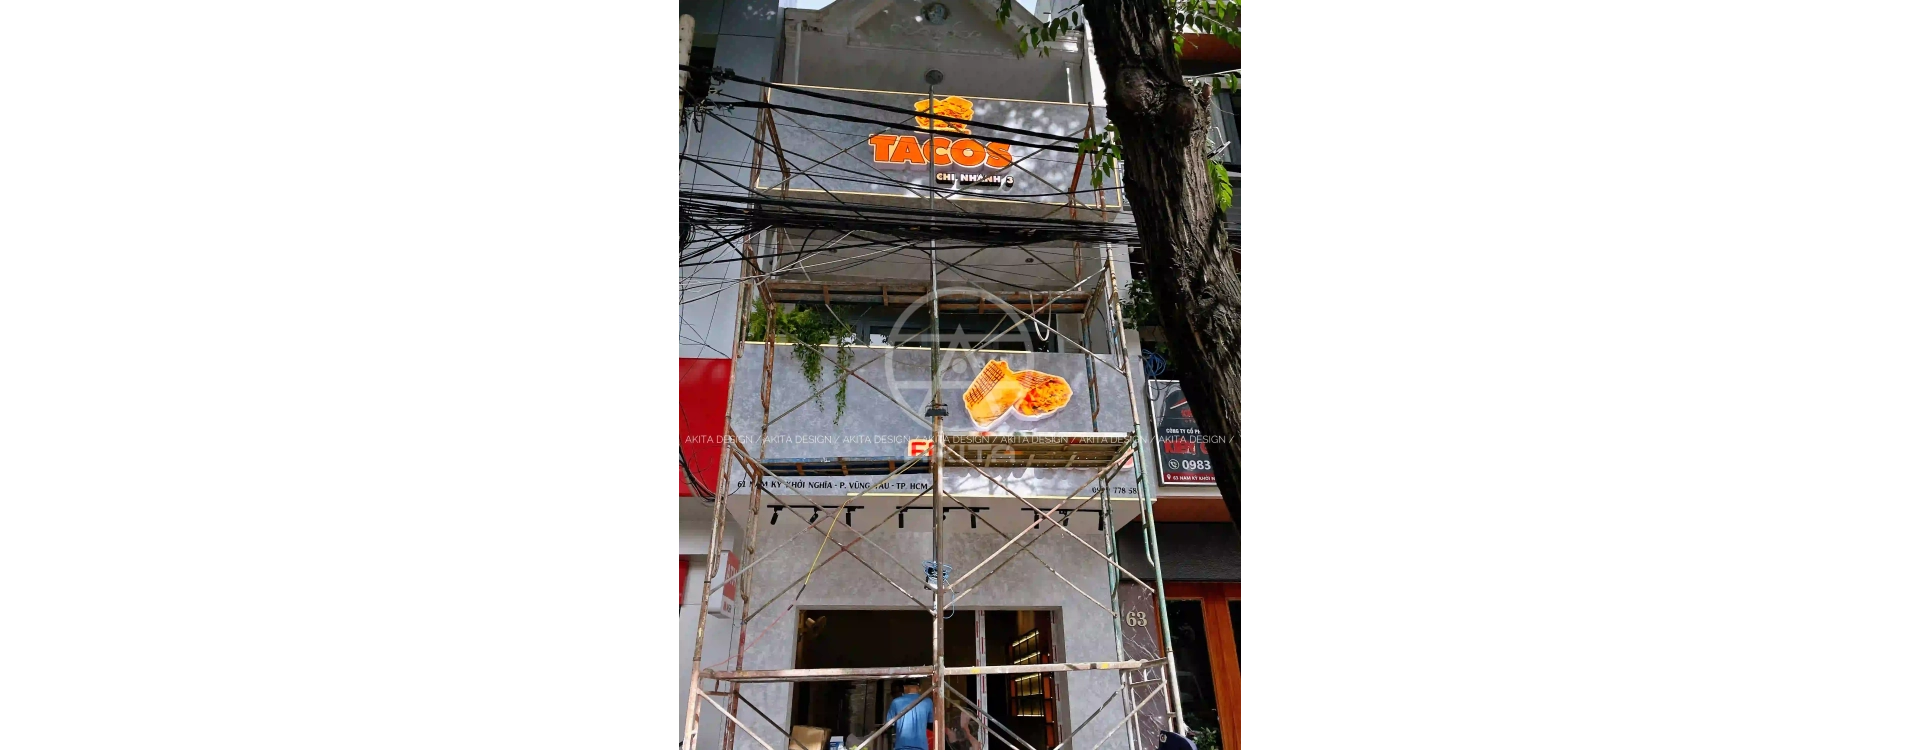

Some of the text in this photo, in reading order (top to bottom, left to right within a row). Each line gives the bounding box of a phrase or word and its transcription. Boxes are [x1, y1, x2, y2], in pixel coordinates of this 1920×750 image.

[869, 134, 1013, 167] TACOS
[936, 172, 955, 181] CHI
[1005, 176, 1014, 184] 3
[1182, 459, 1211, 470] 0983
[839, 481, 847, 489] P.
[910, 482, 928, 490] HCM
[1112, 486, 1126, 494] 778
[1126, 611, 1148, 627] 63
